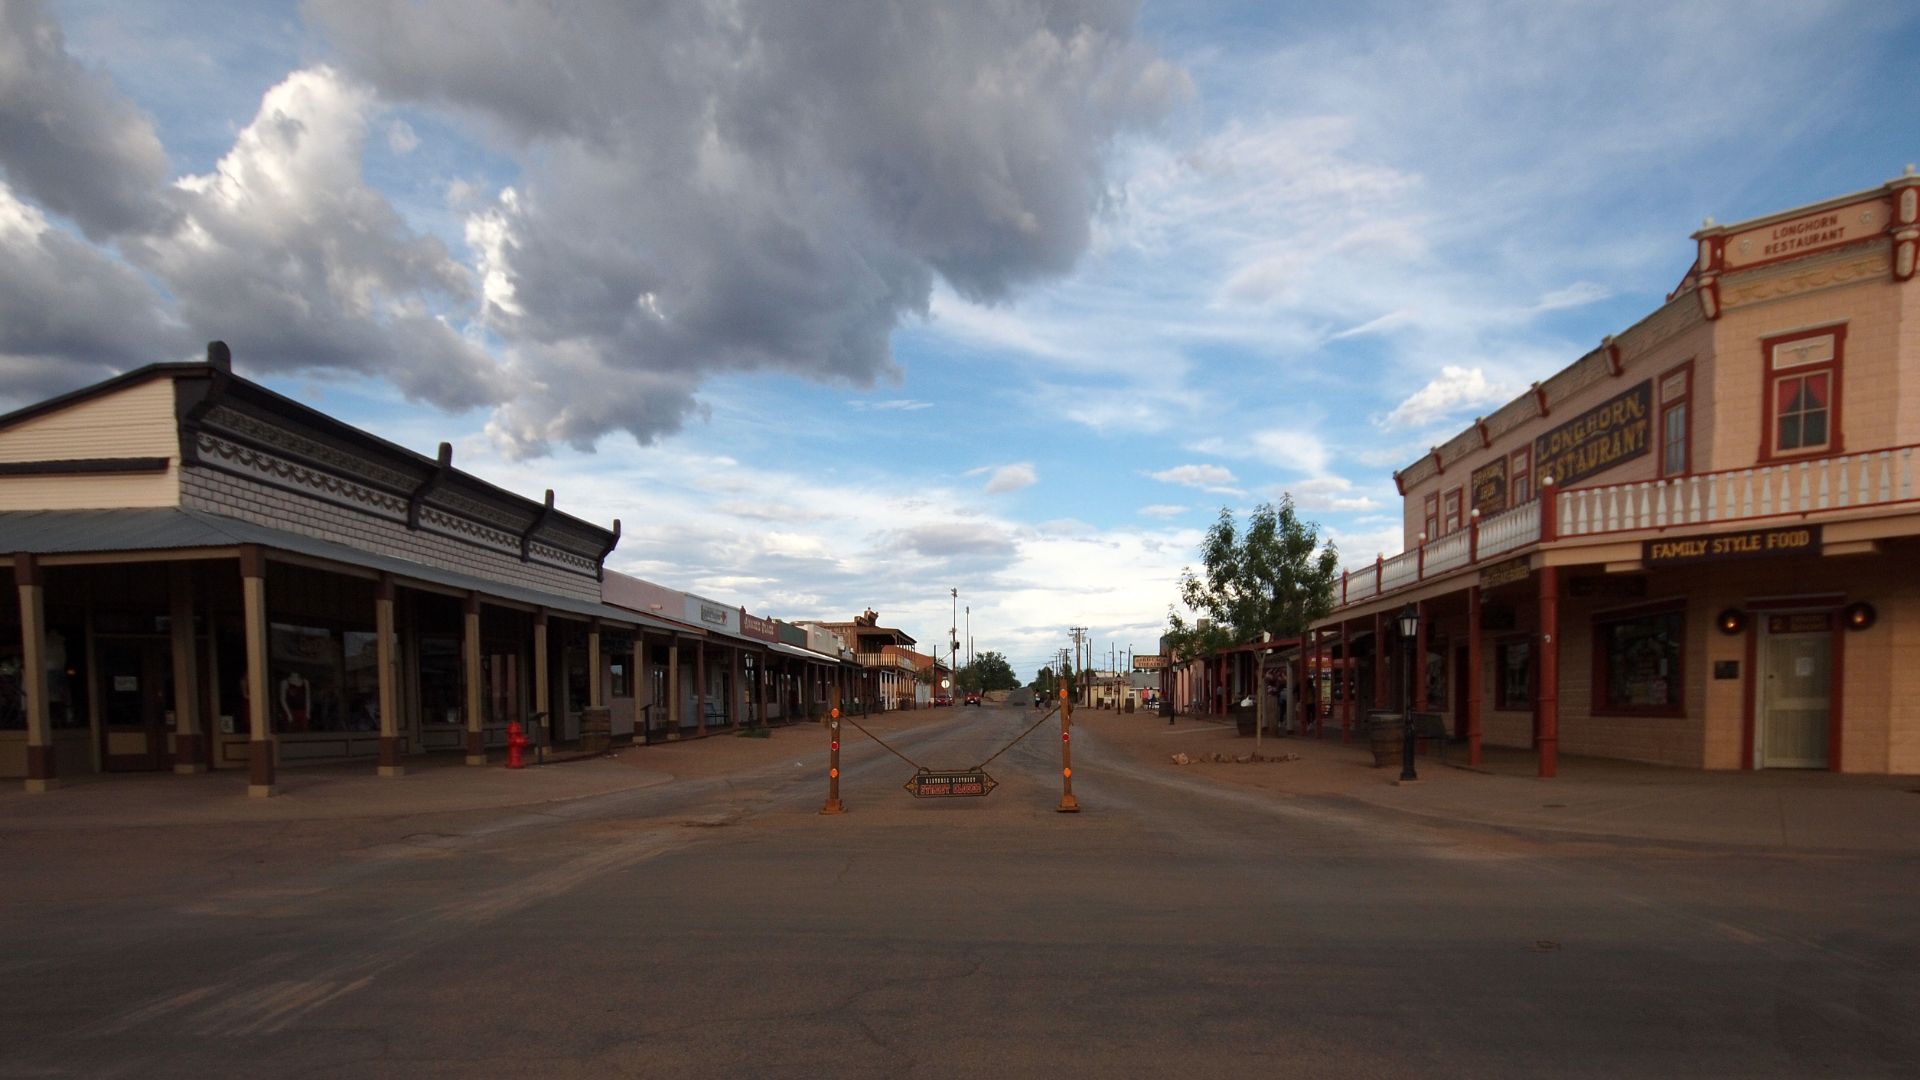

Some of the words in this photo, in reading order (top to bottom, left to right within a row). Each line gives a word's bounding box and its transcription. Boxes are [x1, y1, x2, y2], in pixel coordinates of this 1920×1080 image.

[1763, 226, 1845, 256] RESTAURANT
[1772, 214, 1838, 241] LONGHORN
[1537, 392, 1646, 462] LONGHORN
[1651, 540, 1707, 560] FAMILY
[1713, 534, 1761, 553] STYLE
[1767, 530, 1810, 548] FOOD
